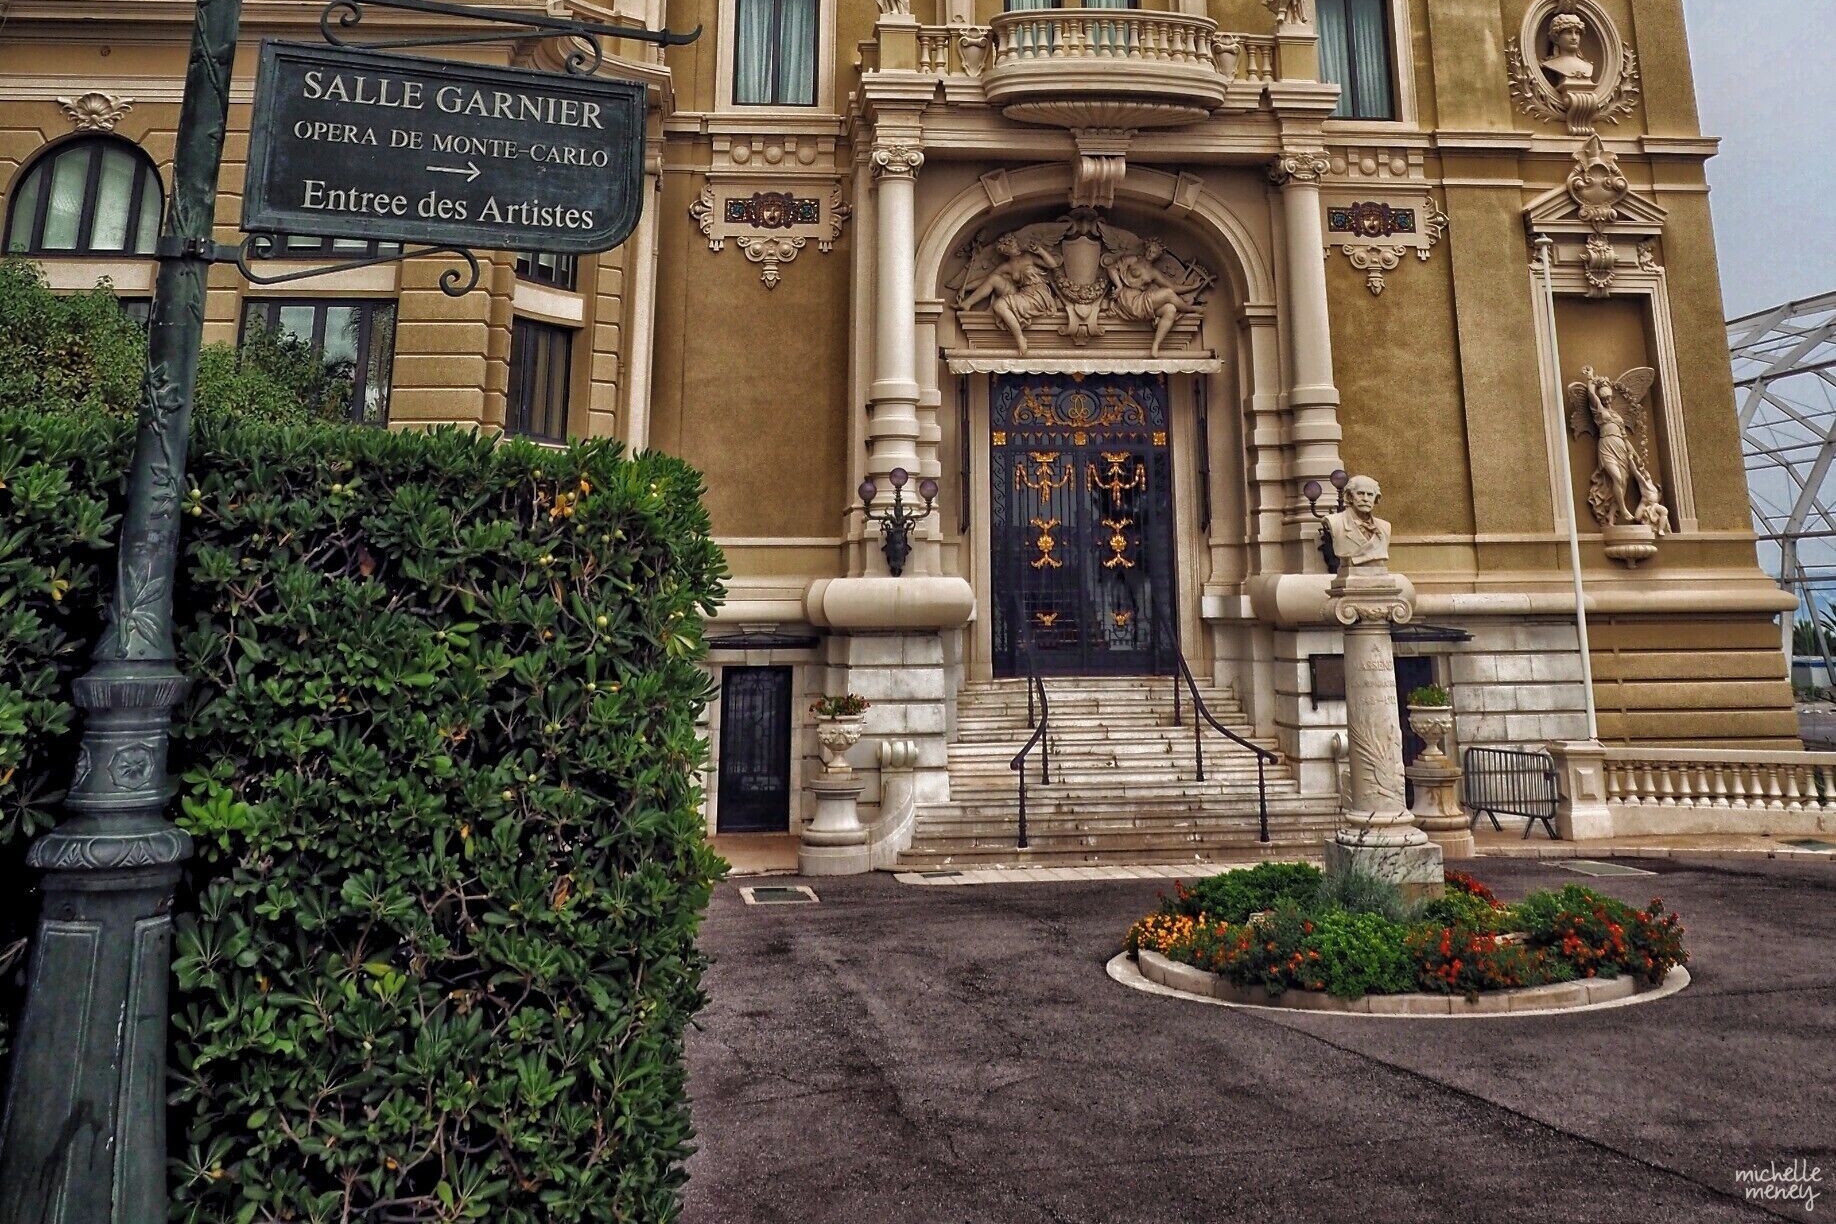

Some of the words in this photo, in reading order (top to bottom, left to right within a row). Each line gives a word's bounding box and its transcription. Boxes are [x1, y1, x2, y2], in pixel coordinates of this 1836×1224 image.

[302, 70, 424, 110] SALLE
[435, 85, 604, 130] GARNIER
[293, 120, 378, 146] OPERA
[389, 129, 424, 150] DE
[431, 133, 608, 168] MONTE-CARLO
[300, 179, 408, 216] Entree
[416, 190, 468, 220] des
[476, 194, 594, 230] Artistes
